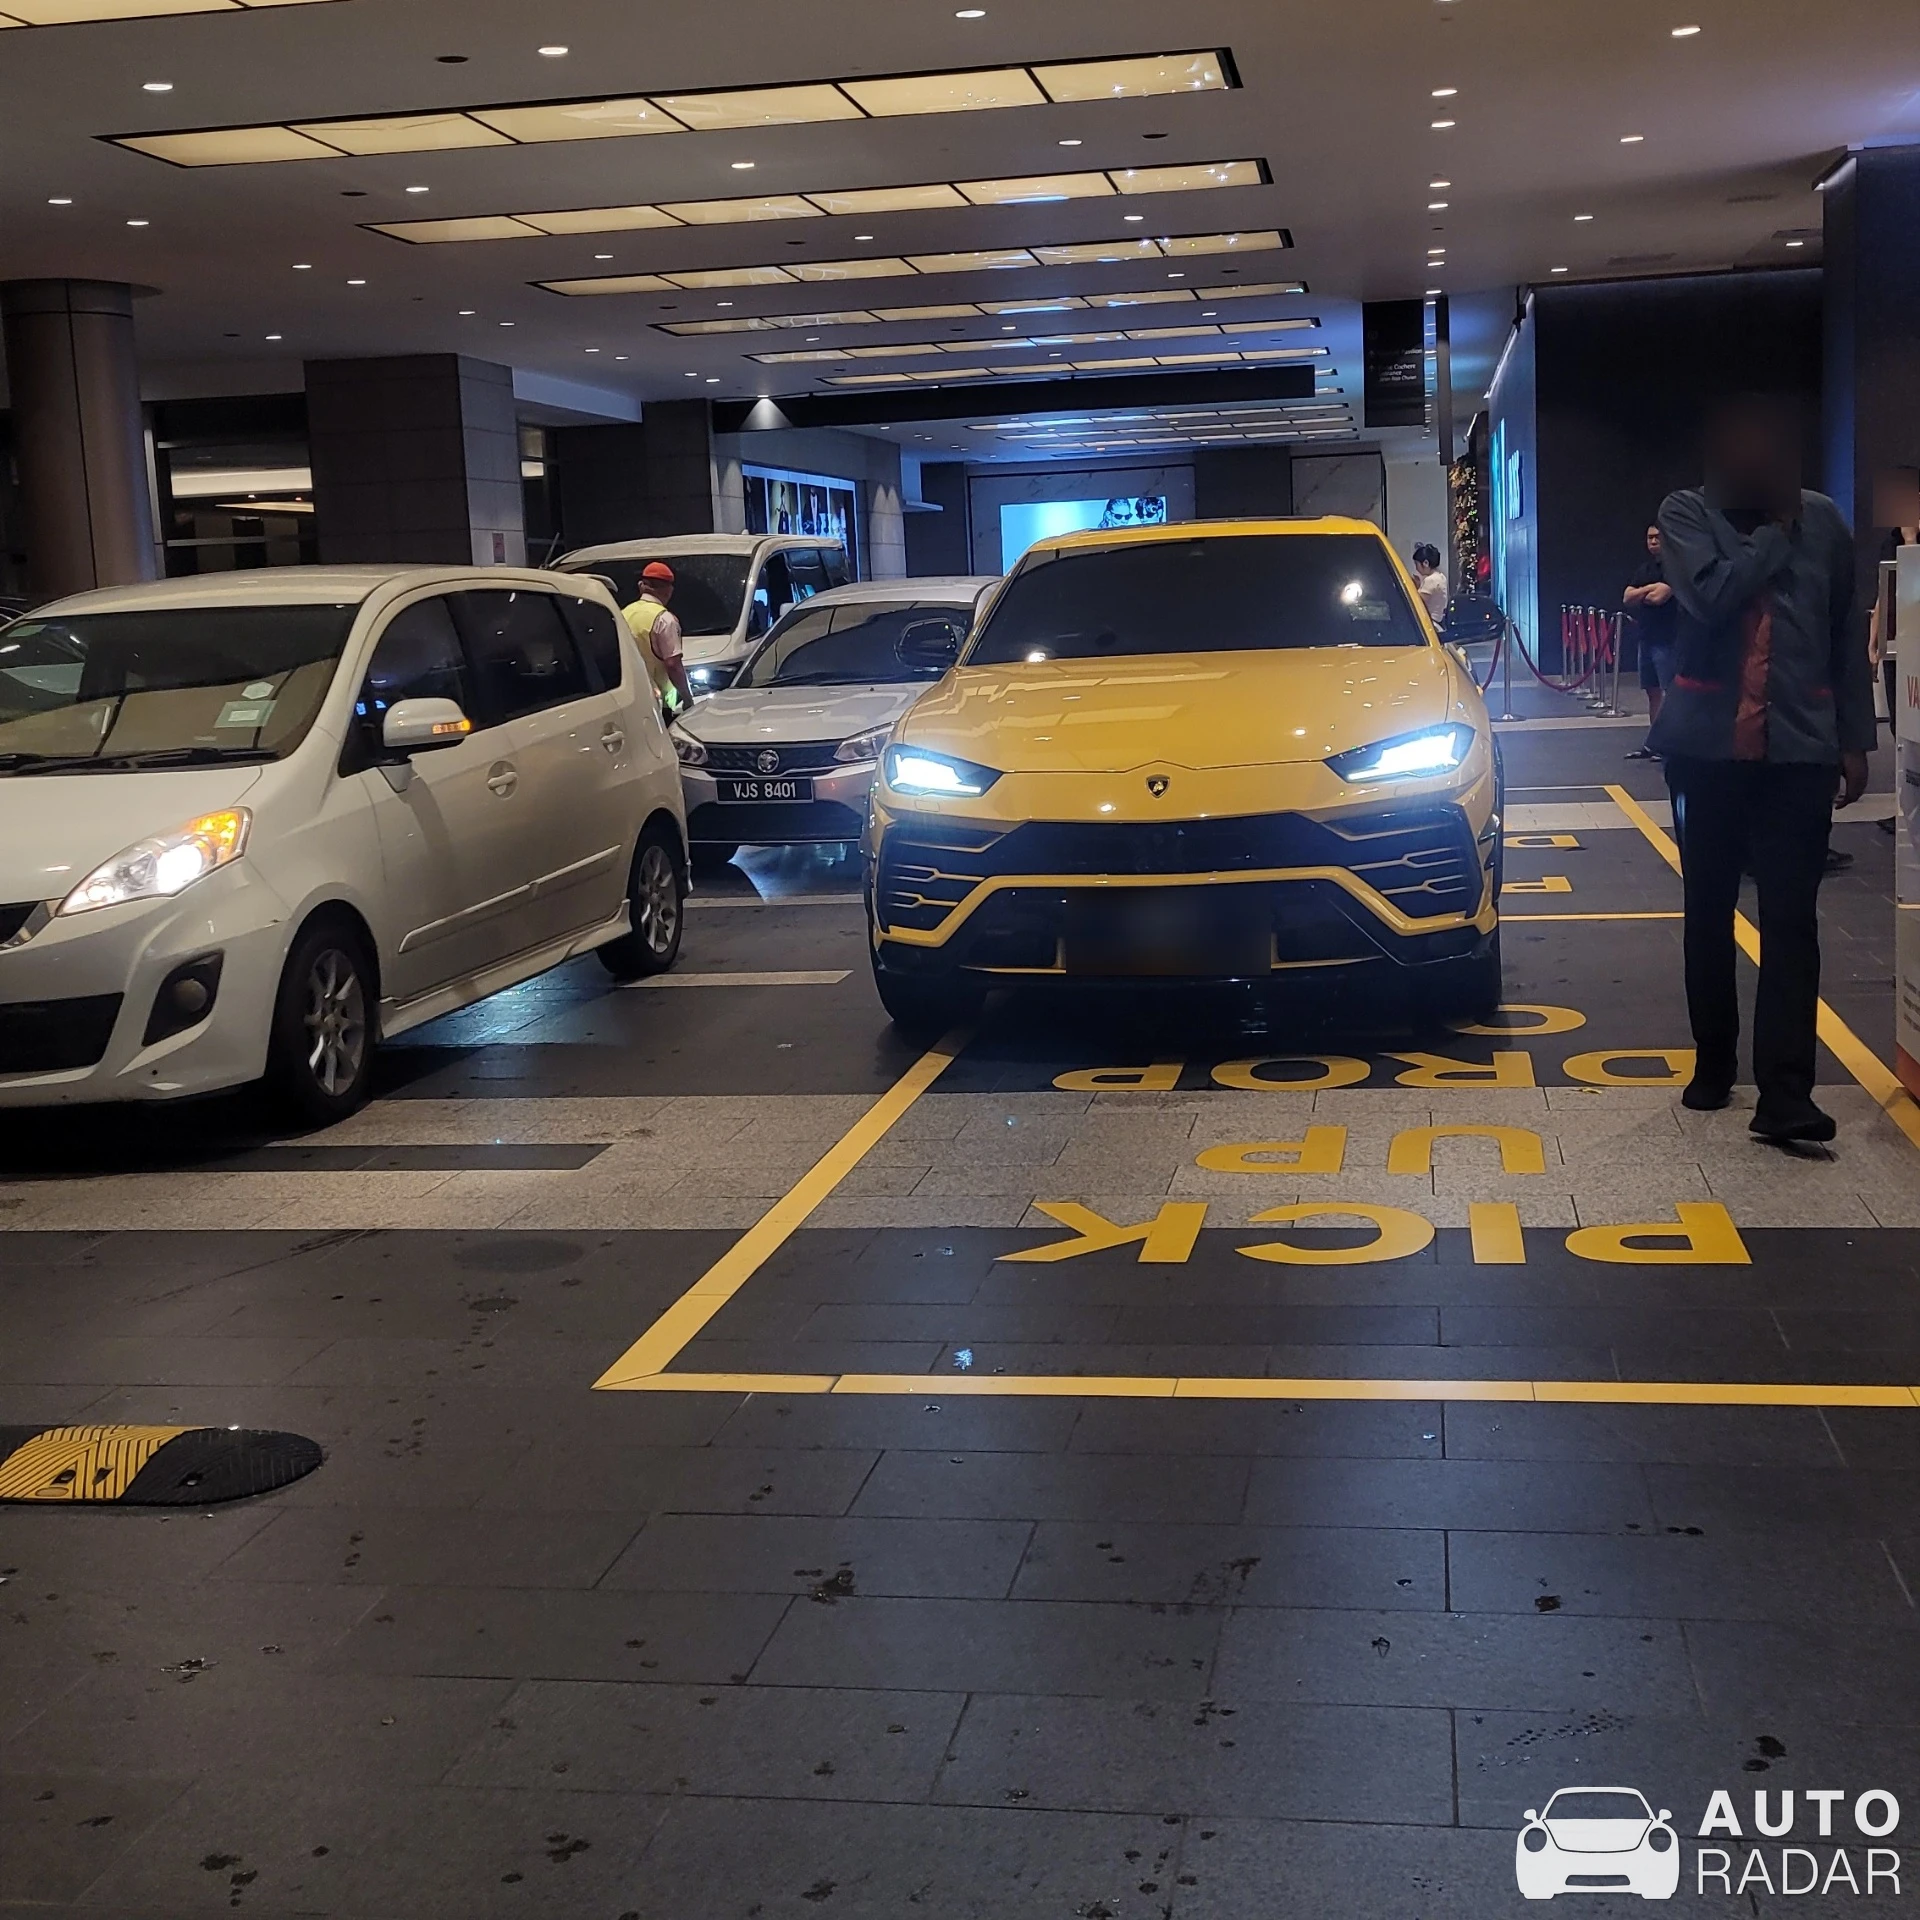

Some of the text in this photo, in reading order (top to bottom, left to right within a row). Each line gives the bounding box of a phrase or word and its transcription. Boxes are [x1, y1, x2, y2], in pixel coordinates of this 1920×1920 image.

[733, 782, 796, 798] VJS 8401
[1051, 1049, 1697, 1092] DROP
[1195, 1125, 1546, 1175] UP
[994, 1202, 1753, 1265] PICK
